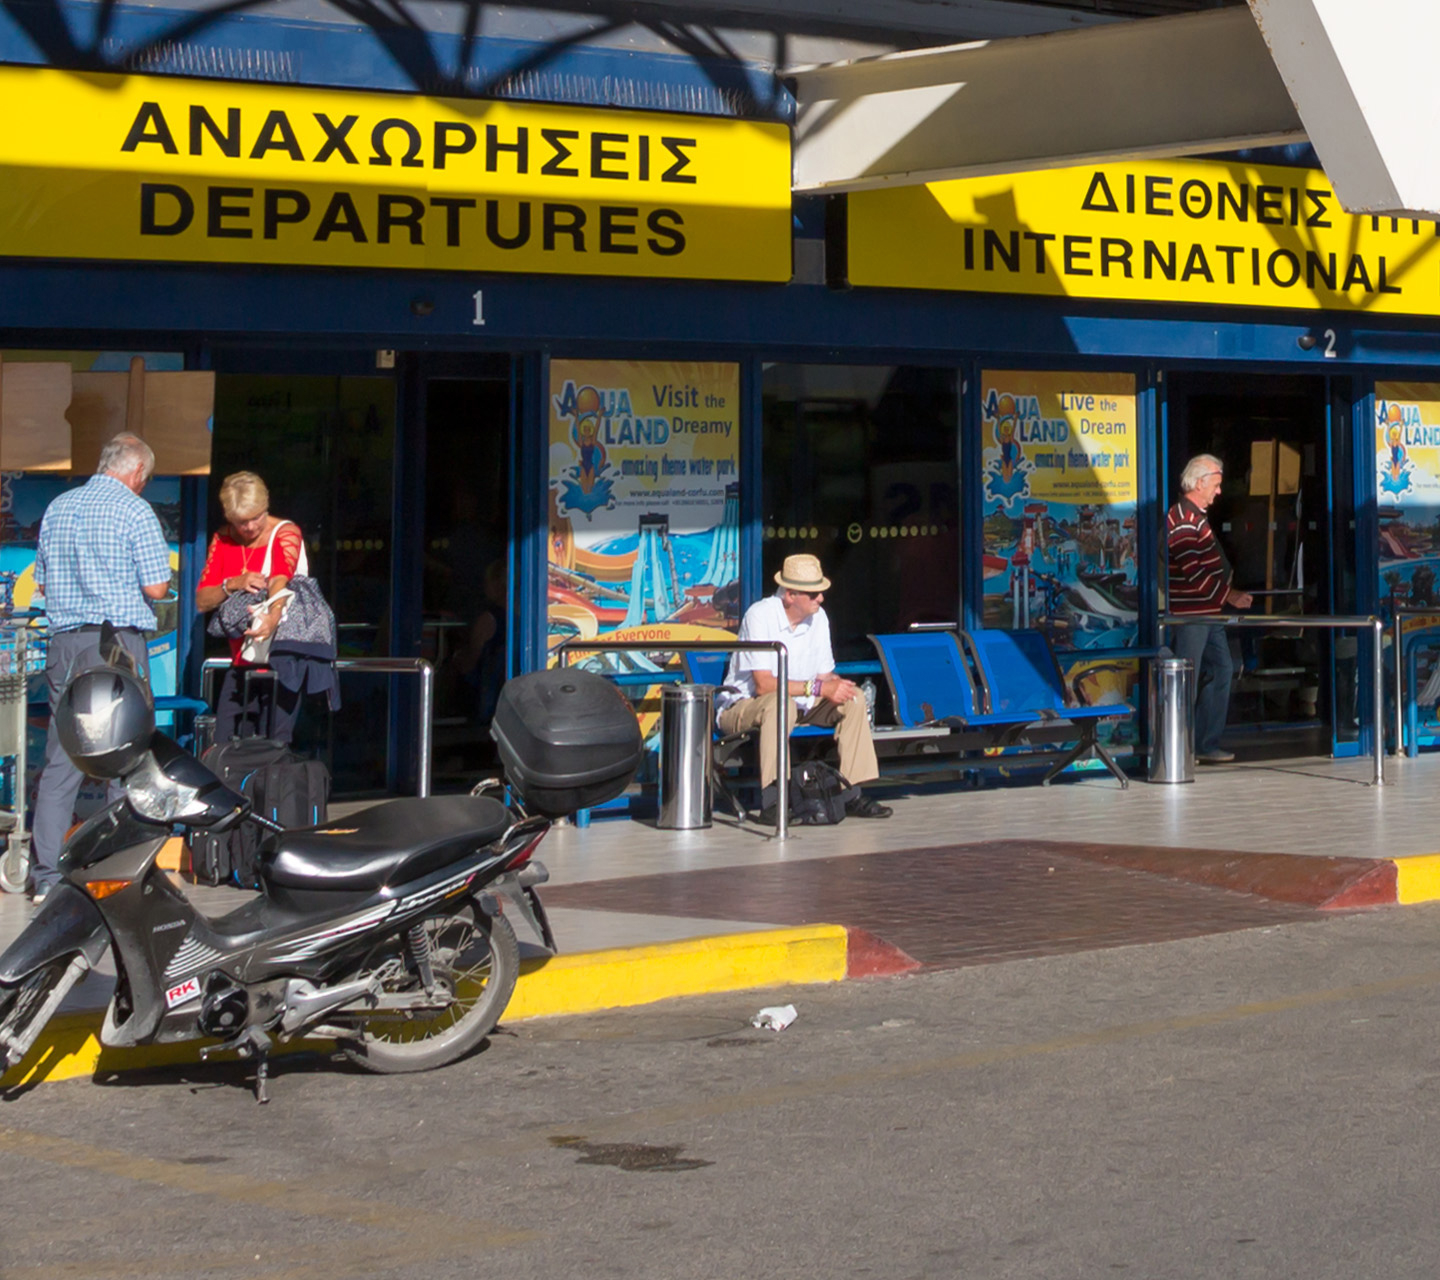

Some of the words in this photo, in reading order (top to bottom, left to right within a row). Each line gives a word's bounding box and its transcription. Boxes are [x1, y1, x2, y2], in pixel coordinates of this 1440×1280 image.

[120, 101, 697, 185] ΑΝΑΧΩΡΗΣΕΙΣ
[1081, 172, 1332, 229] ΔΙΕΘΝΕΙΣ
[139, 183, 687, 256] DEPARTURES
[963, 227, 1402, 296] INTERNATIONAL
[472, 290, 485, 325] 1
[1324, 328, 1337, 358] 2
[652, 385, 699, 408] Visit
[705, 394, 725, 408] the
[1061, 391, 1094, 411] Live
[1100, 400, 1117, 411] the
[604, 419, 669, 445] LAND
[672, 417, 732, 437] Dreamy
[1019, 420, 1069, 442] LAND
[1080, 418, 1126, 435] Dream
[621, 453, 659, 482] amazing
[661, 453, 686, 475] theme
[688, 456, 714, 476] water
[716, 453, 736, 482] park
[1068, 448, 1088, 468] theme
[1091, 451, 1112, 468] water
[1114, 448, 1129, 473] park
[615, 628, 671, 642] Everyone
[168, 980, 196, 1001] RK
